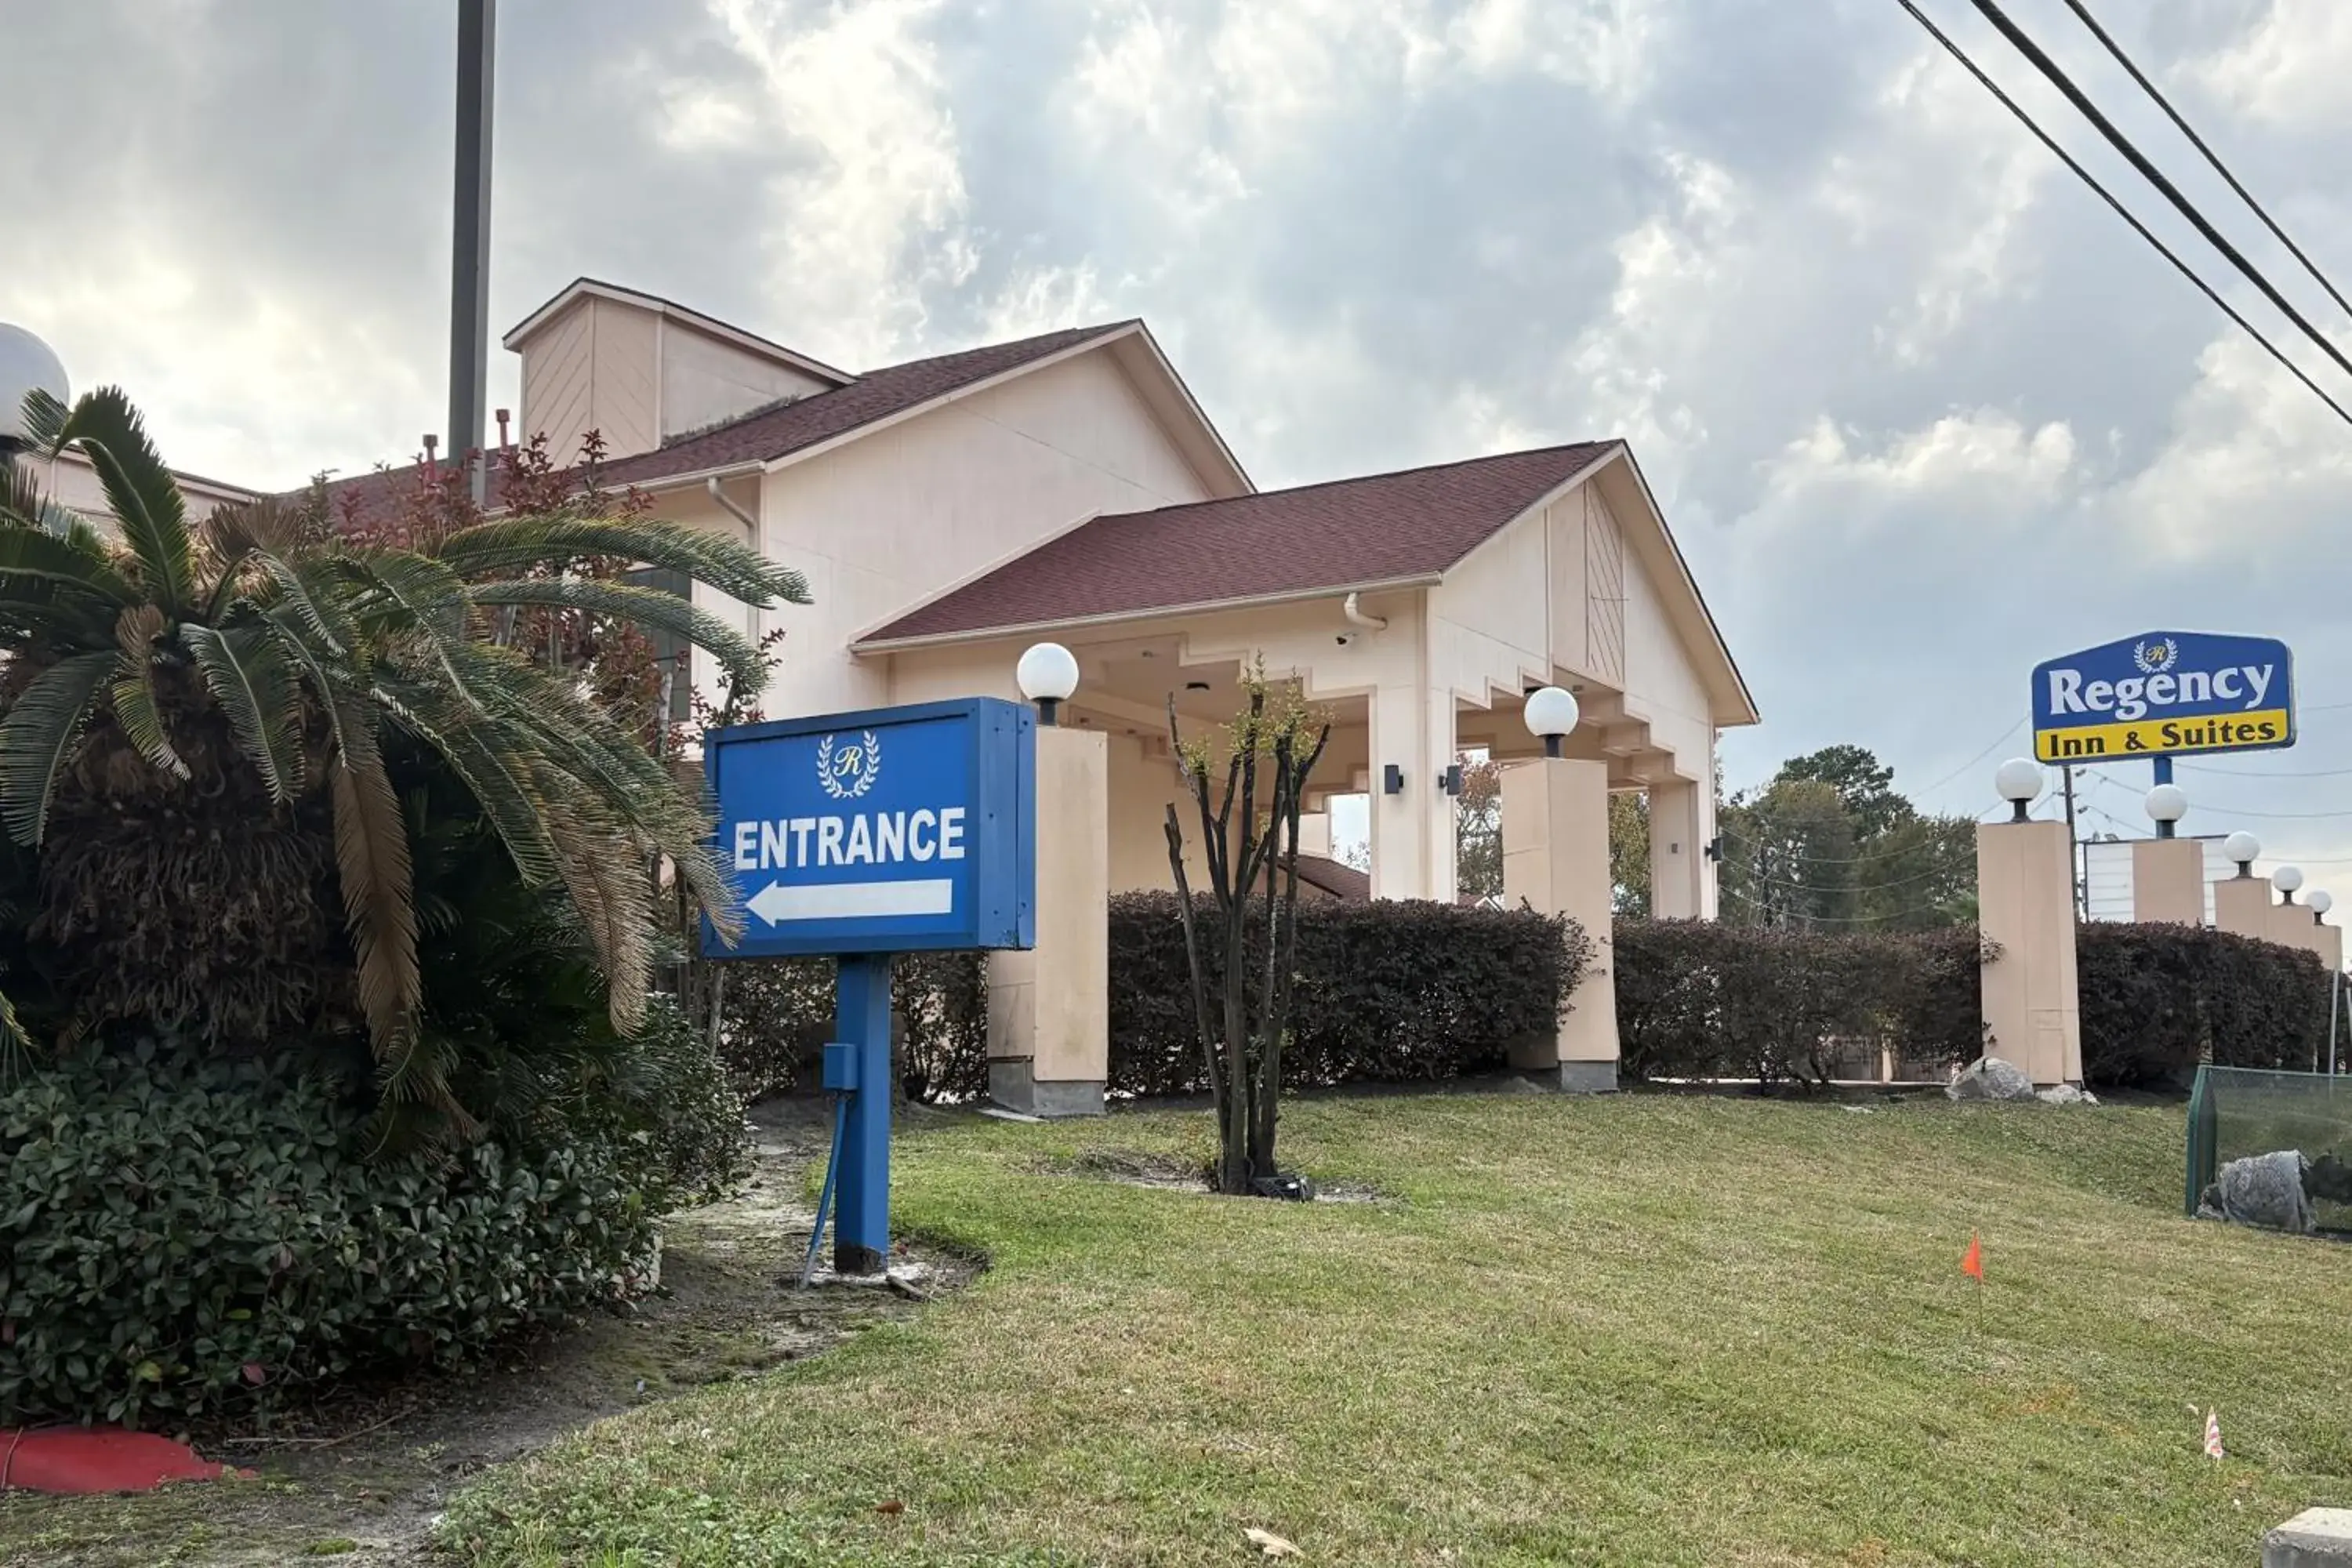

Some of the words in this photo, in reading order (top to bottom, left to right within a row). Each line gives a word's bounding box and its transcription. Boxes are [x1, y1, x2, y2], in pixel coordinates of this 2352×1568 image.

[2048, 664, 2273, 720] Regency
[834, 745, 862, 776] R
[2050, 734, 2105, 757] Inn
[2125, 731, 2148, 752] &
[2161, 720, 2276, 748] Suites
[734, 807, 965, 871] ENTRANCE
